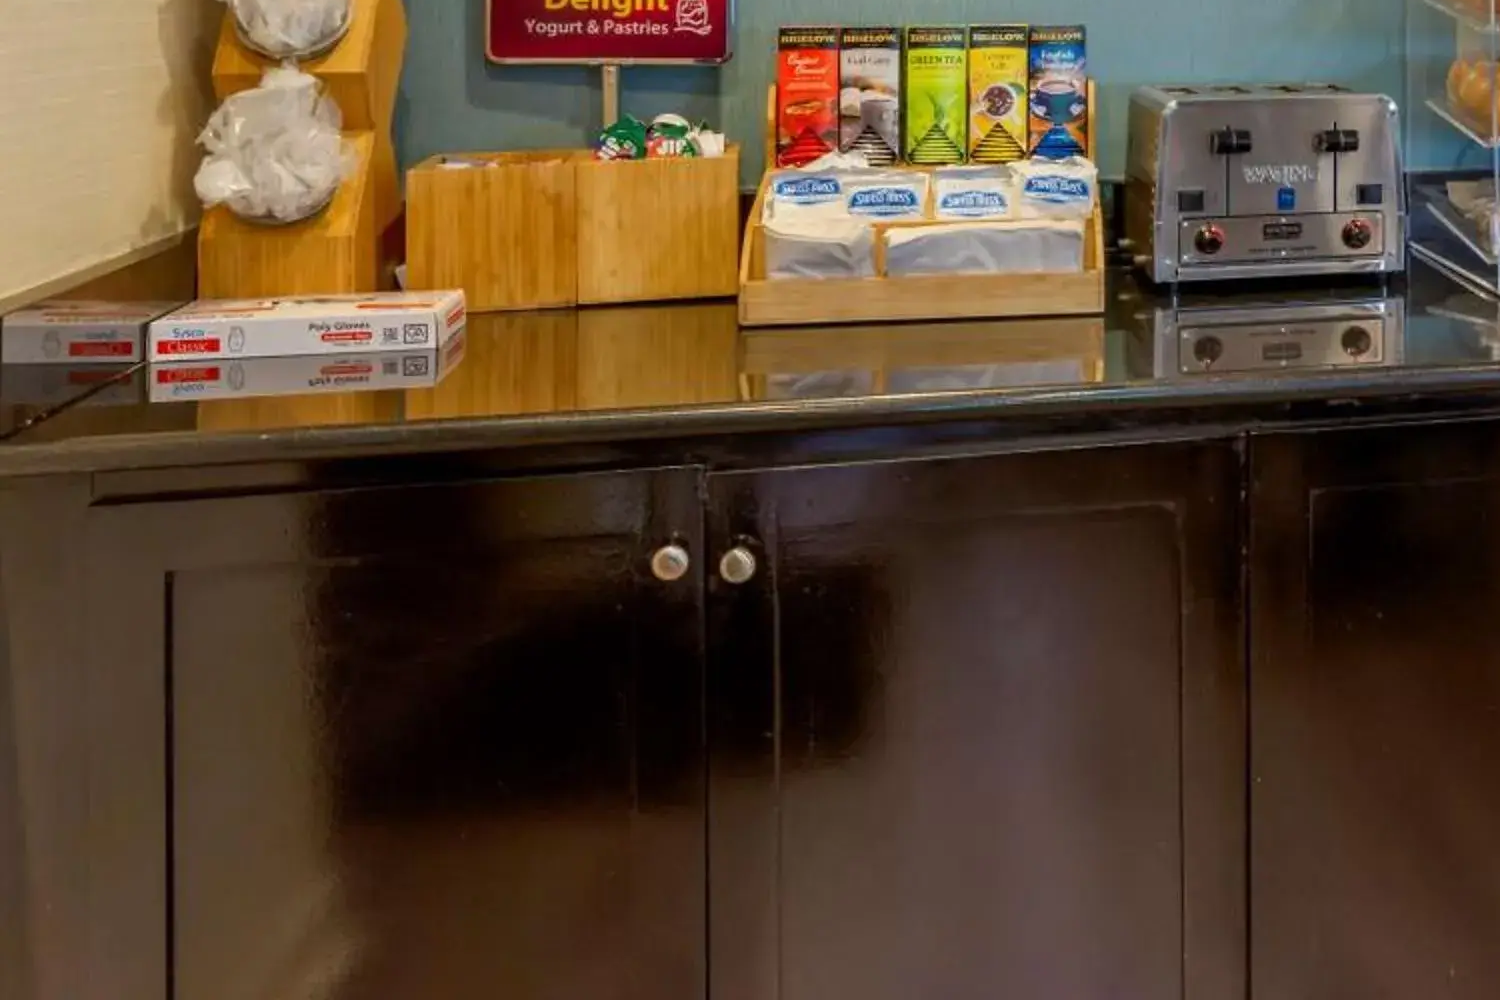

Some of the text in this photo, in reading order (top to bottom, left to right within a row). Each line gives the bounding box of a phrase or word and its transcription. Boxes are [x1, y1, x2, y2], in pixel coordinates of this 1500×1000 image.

[524, 18, 669, 37] Yogurt & Pastries
[910, 55, 963, 65] GREEN TEA
